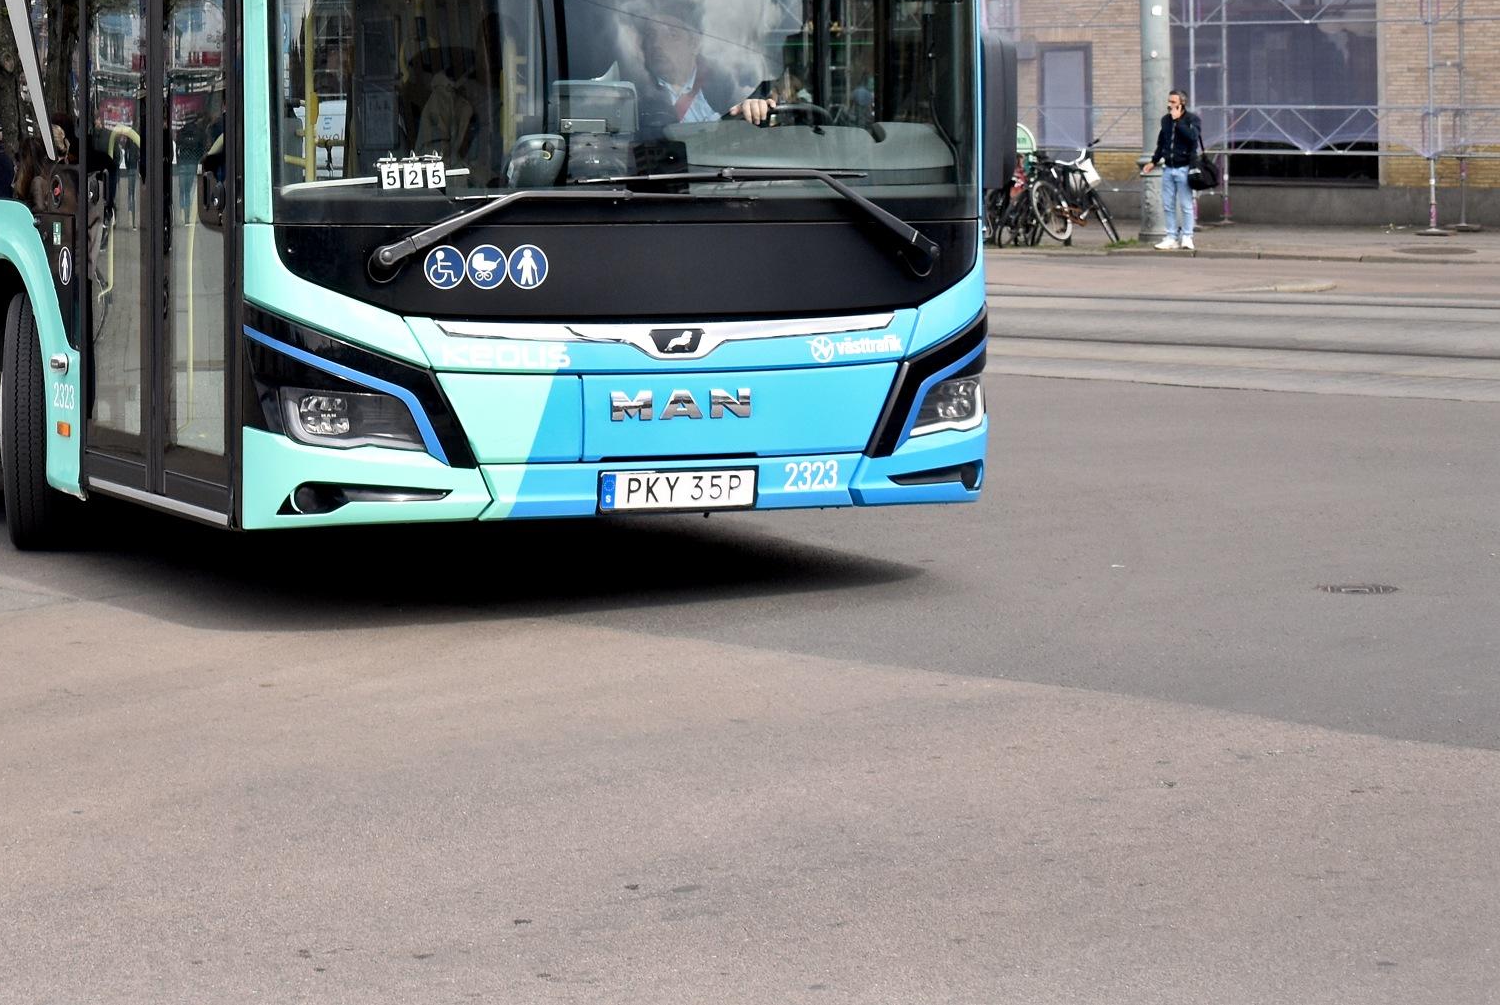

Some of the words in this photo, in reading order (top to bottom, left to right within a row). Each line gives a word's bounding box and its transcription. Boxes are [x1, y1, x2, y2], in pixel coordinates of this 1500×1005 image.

[836, 334, 903, 355] västtrafik
[53, 382, 75, 411] 2323
[610, 387, 751, 421] MAN
[626, 476, 681, 504] PKY
[690, 474, 742, 501] 35P
[783, 459, 839, 492] 2323
